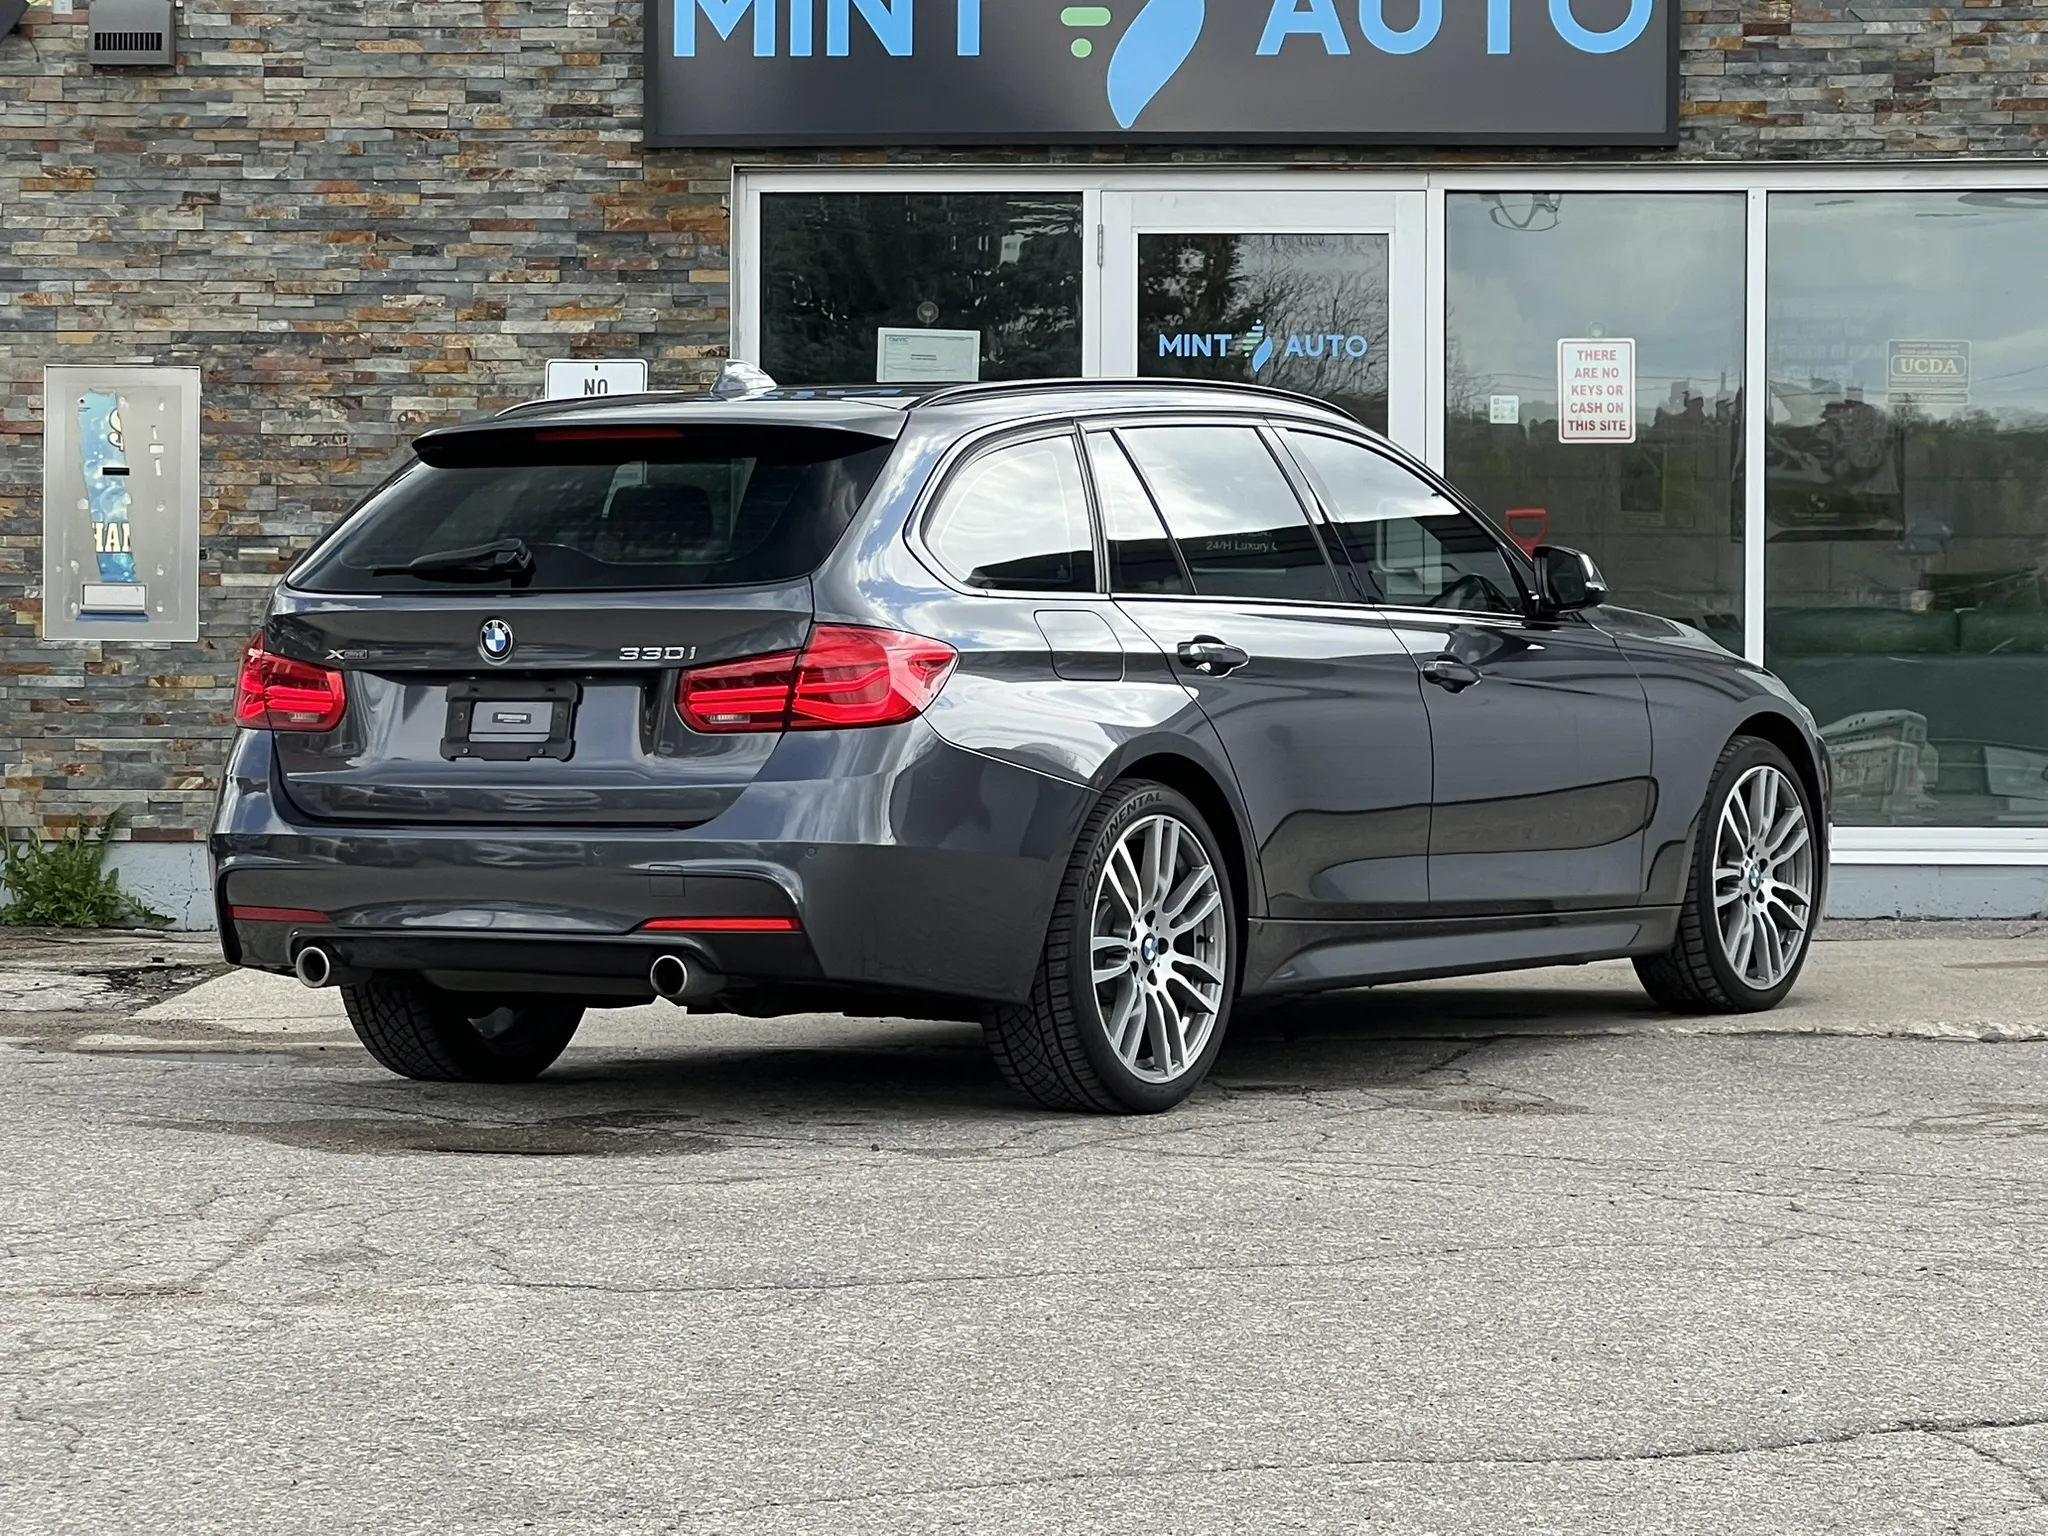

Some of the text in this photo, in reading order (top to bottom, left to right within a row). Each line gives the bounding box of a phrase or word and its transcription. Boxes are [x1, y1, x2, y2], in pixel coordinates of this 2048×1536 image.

[1159, 334, 1368, 358] MINT AUTO
[1577, 350, 1617, 361] THERE
[1900, 358, 1958, 374] UCDA
[1574, 367, 1619, 378] ARE NO
[584, 379, 608, 395] NO
[1571, 385, 1624, 396] KEYS OR
[1570, 402, 1624, 414] CASH ON
[1568, 420, 1627, 432] THIS SITE
[1234, 541, 1269, 553] Luxury
[619, 646, 697, 660] 330i
